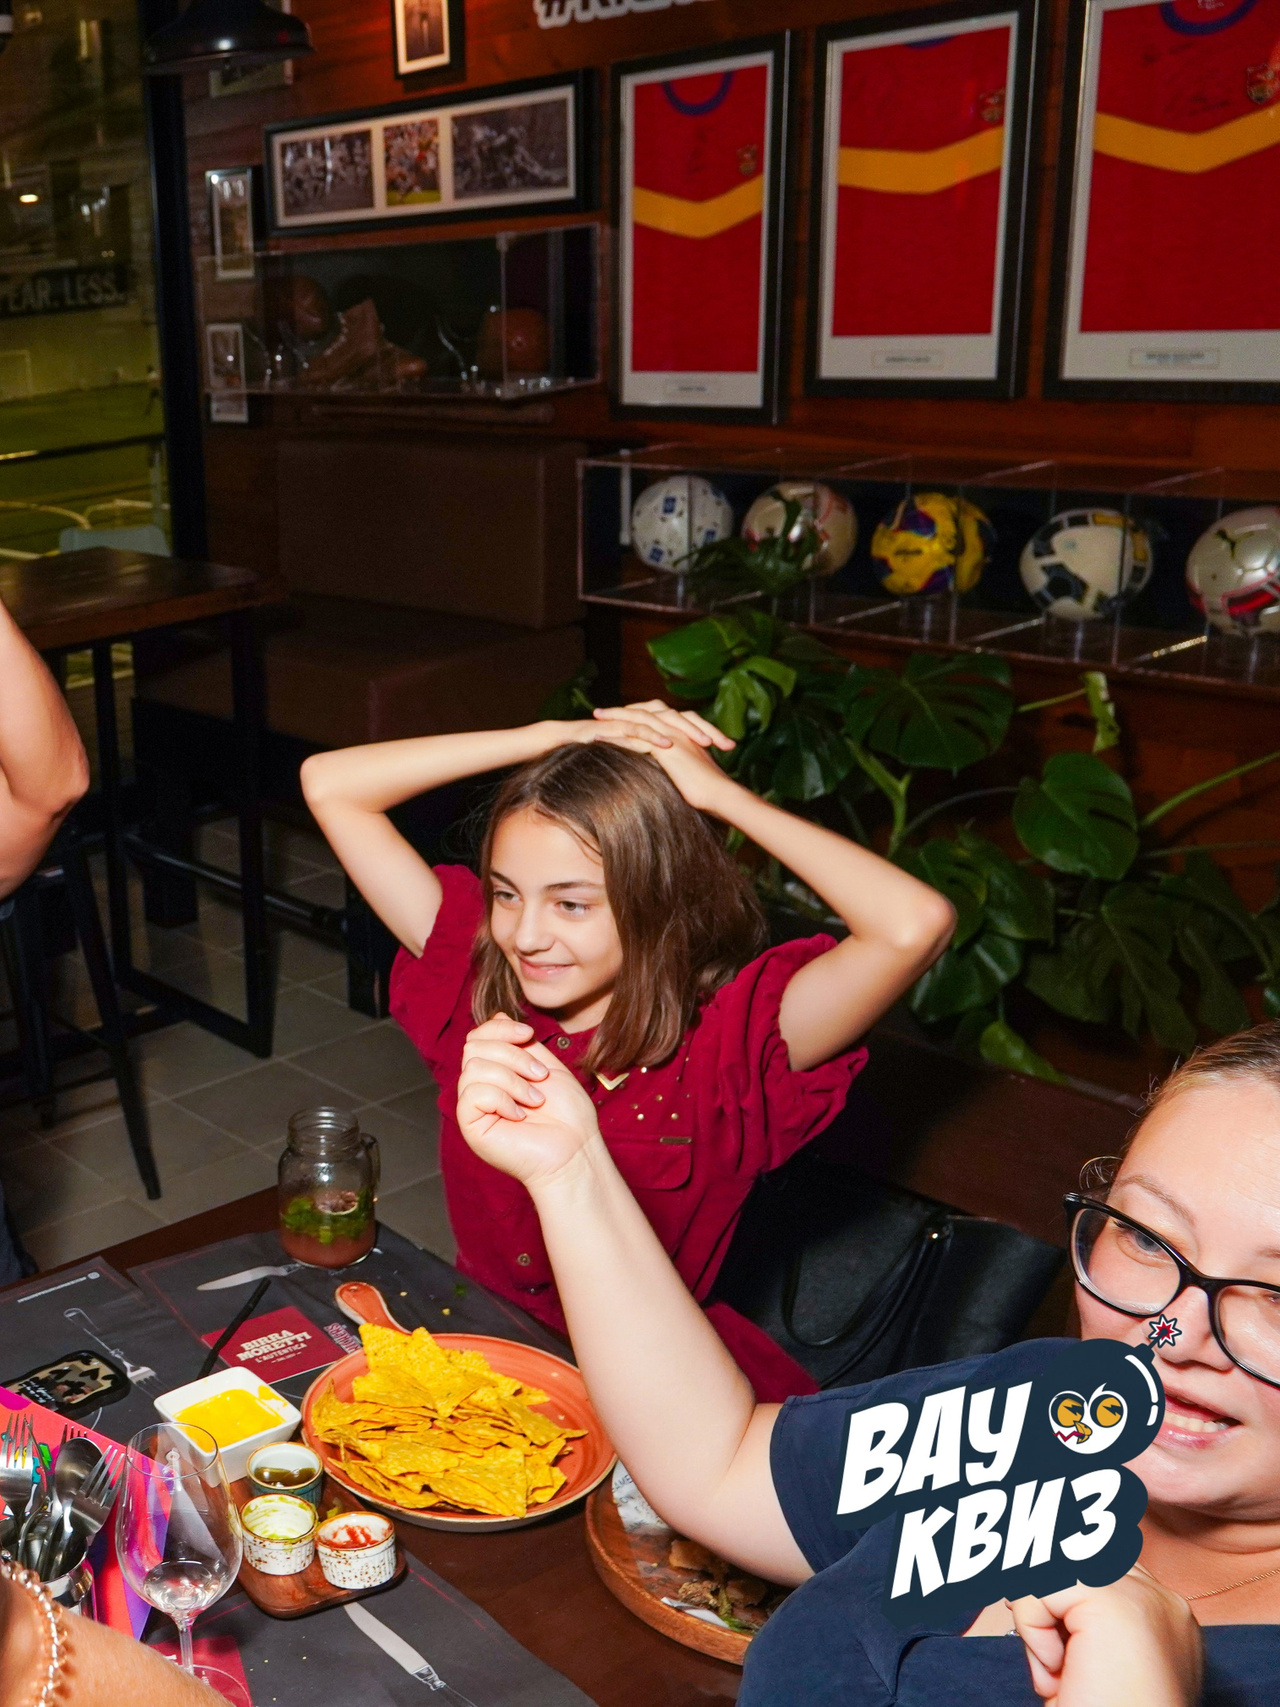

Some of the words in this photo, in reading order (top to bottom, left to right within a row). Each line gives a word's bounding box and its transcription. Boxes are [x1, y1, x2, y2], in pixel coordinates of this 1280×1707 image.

[236, 1331, 312, 1361] MORETTI
[241, 1330, 295, 1351] BIRRA
[255, 1342, 308, 1363] L'AUTENTICA
